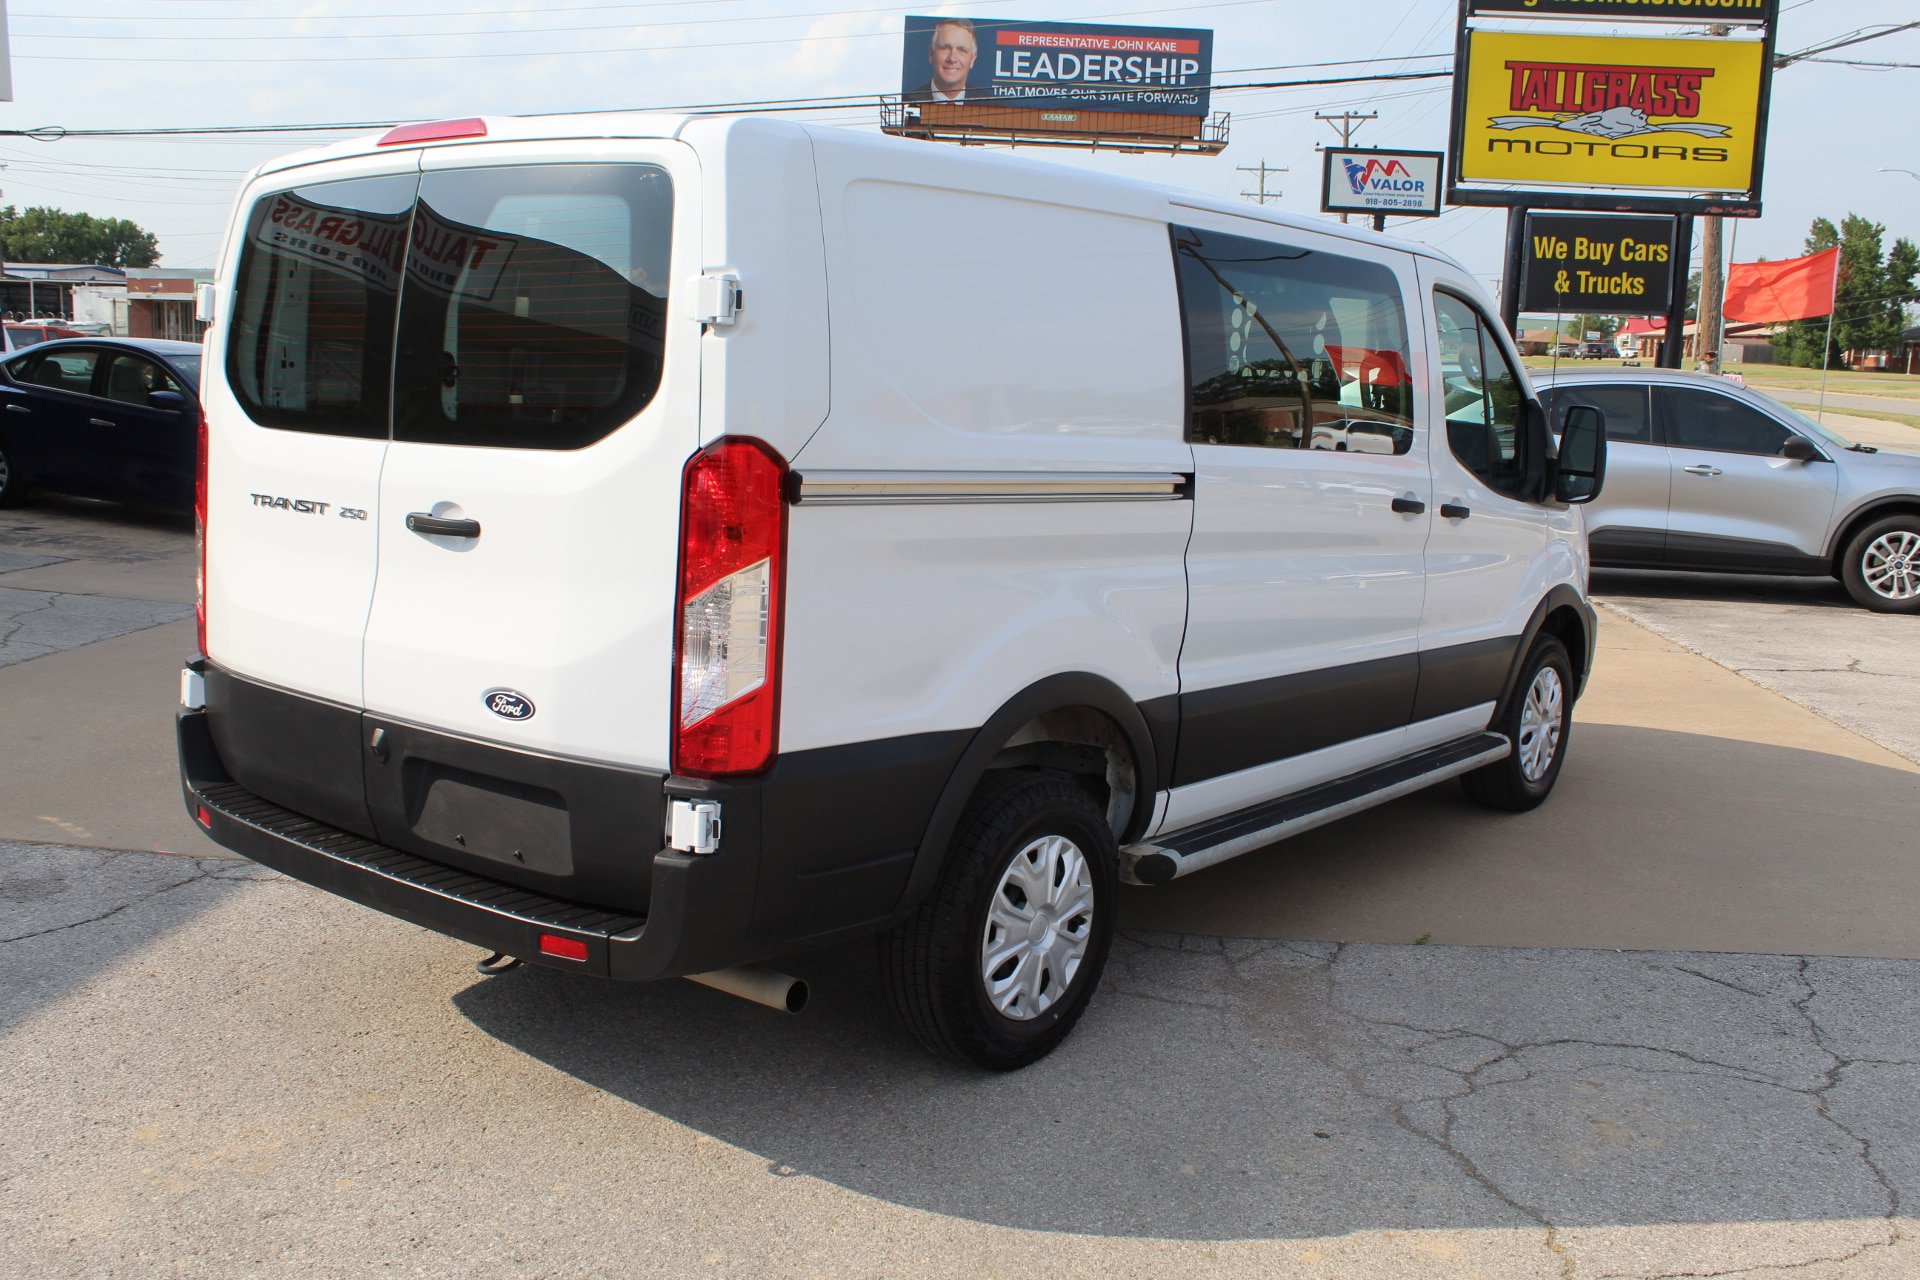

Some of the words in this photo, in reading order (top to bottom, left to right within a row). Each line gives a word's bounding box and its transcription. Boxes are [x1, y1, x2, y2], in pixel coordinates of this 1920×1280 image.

[1018, 35, 1110, 49] REPRESENTATIVE
[1112, 39, 1144, 51] JOHN
[1146, 41, 1177, 52] KANE
[995, 50, 1200, 85] LEADERSHIP
[992, 85, 1023, 97] THAT
[1025, 87, 1067, 98] MOVES
[1071, 89, 1097, 100] OUR
[1100, 91, 1134, 102] STATE
[1137, 93, 1199, 105] FORWARD
[1504, 60, 1715, 118] TALLGRASS
[1371, 179, 1425, 192] VALOR
[1365, 198, 1423, 207] 918-805-2898
[1533, 237, 1568, 259] We
[1575, 238, 1615, 265] Buy
[1620, 238, 1668, 262] Cars
[1554, 270, 1570, 293] &
[1576, 271, 1645, 295] Trucks
[250, 493, 330, 516] TRANSIT
[339, 507, 368, 521] 250
[491, 694, 523, 717] Ford
